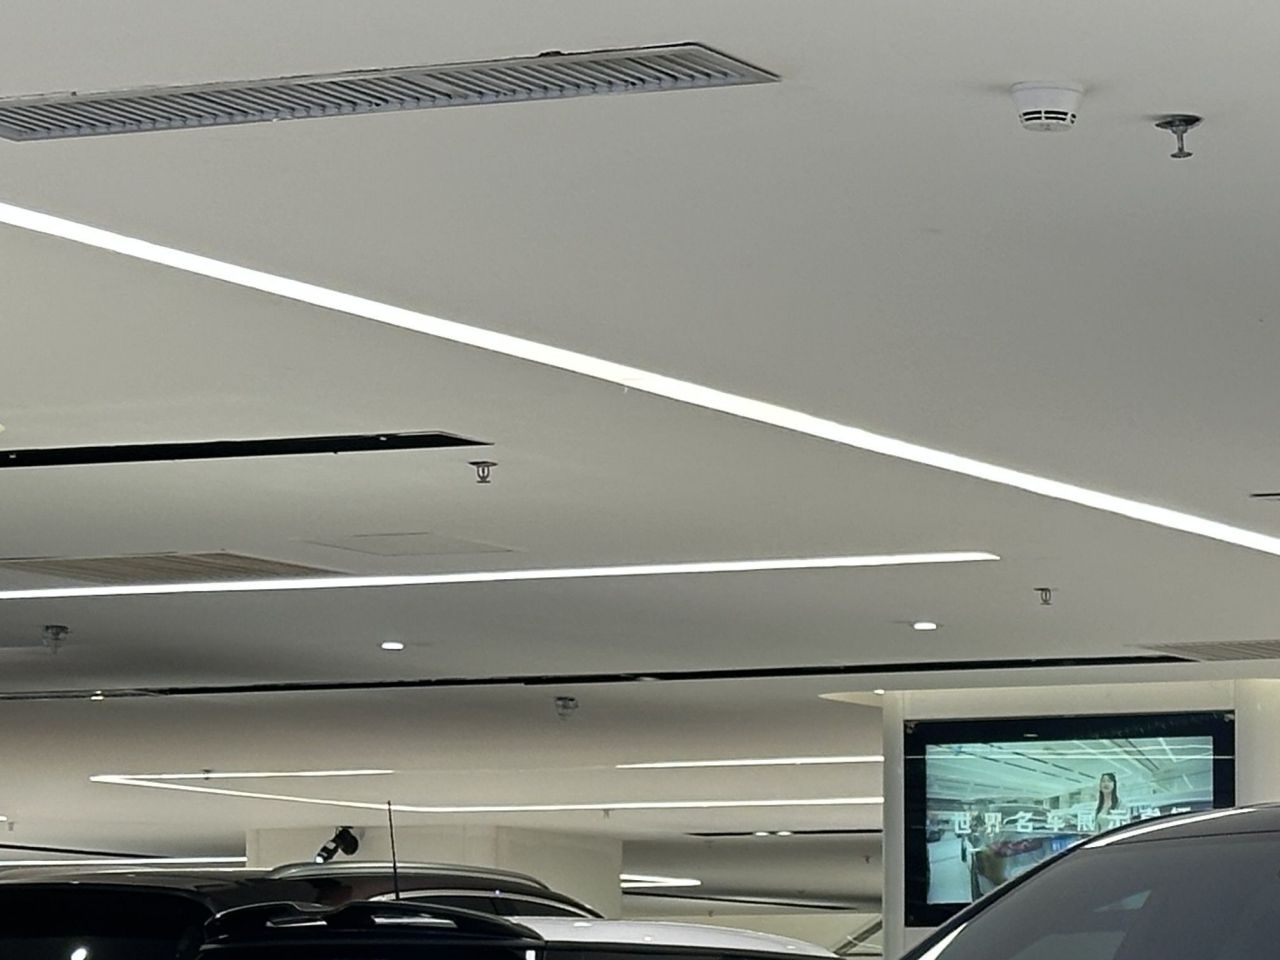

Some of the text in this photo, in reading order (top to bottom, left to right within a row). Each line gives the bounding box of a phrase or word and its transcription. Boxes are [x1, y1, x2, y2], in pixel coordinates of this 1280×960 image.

[953, 807, 1191, 834] 世界名车展示
